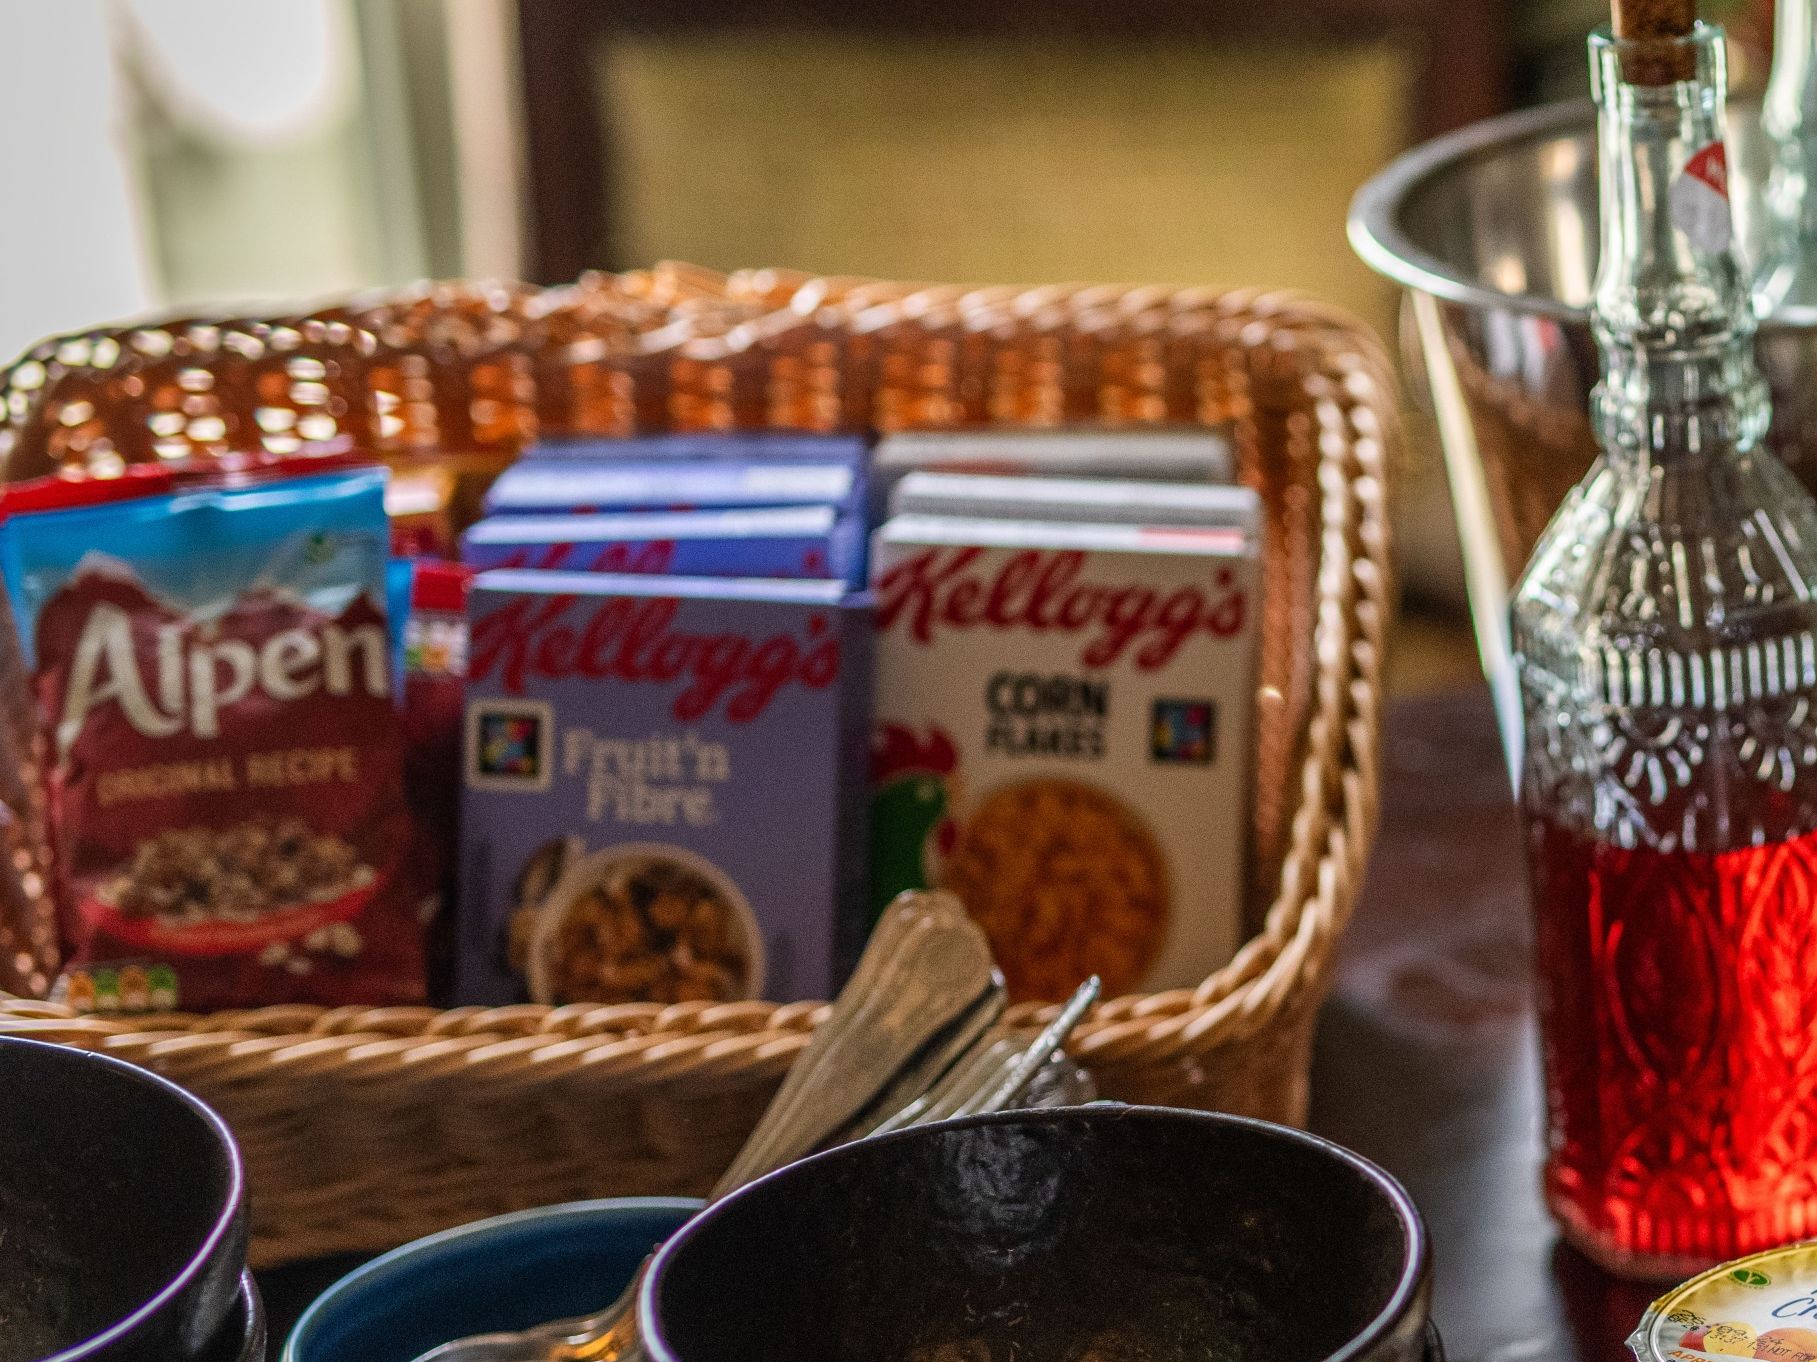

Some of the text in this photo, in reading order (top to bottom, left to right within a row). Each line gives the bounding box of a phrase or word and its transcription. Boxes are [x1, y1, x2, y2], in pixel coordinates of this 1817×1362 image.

[878, 548, 1247, 671] Kellogg's
[57, 603, 387, 765] Alpen
[467, 593, 840, 724] Kellogg's
[987, 672, 1108, 717] CORN
[987, 719, 1104, 756] FLAKES
[101, 746, 360, 804] ORIGINAL RECIPE
[586, 771, 715, 826] Fibre
